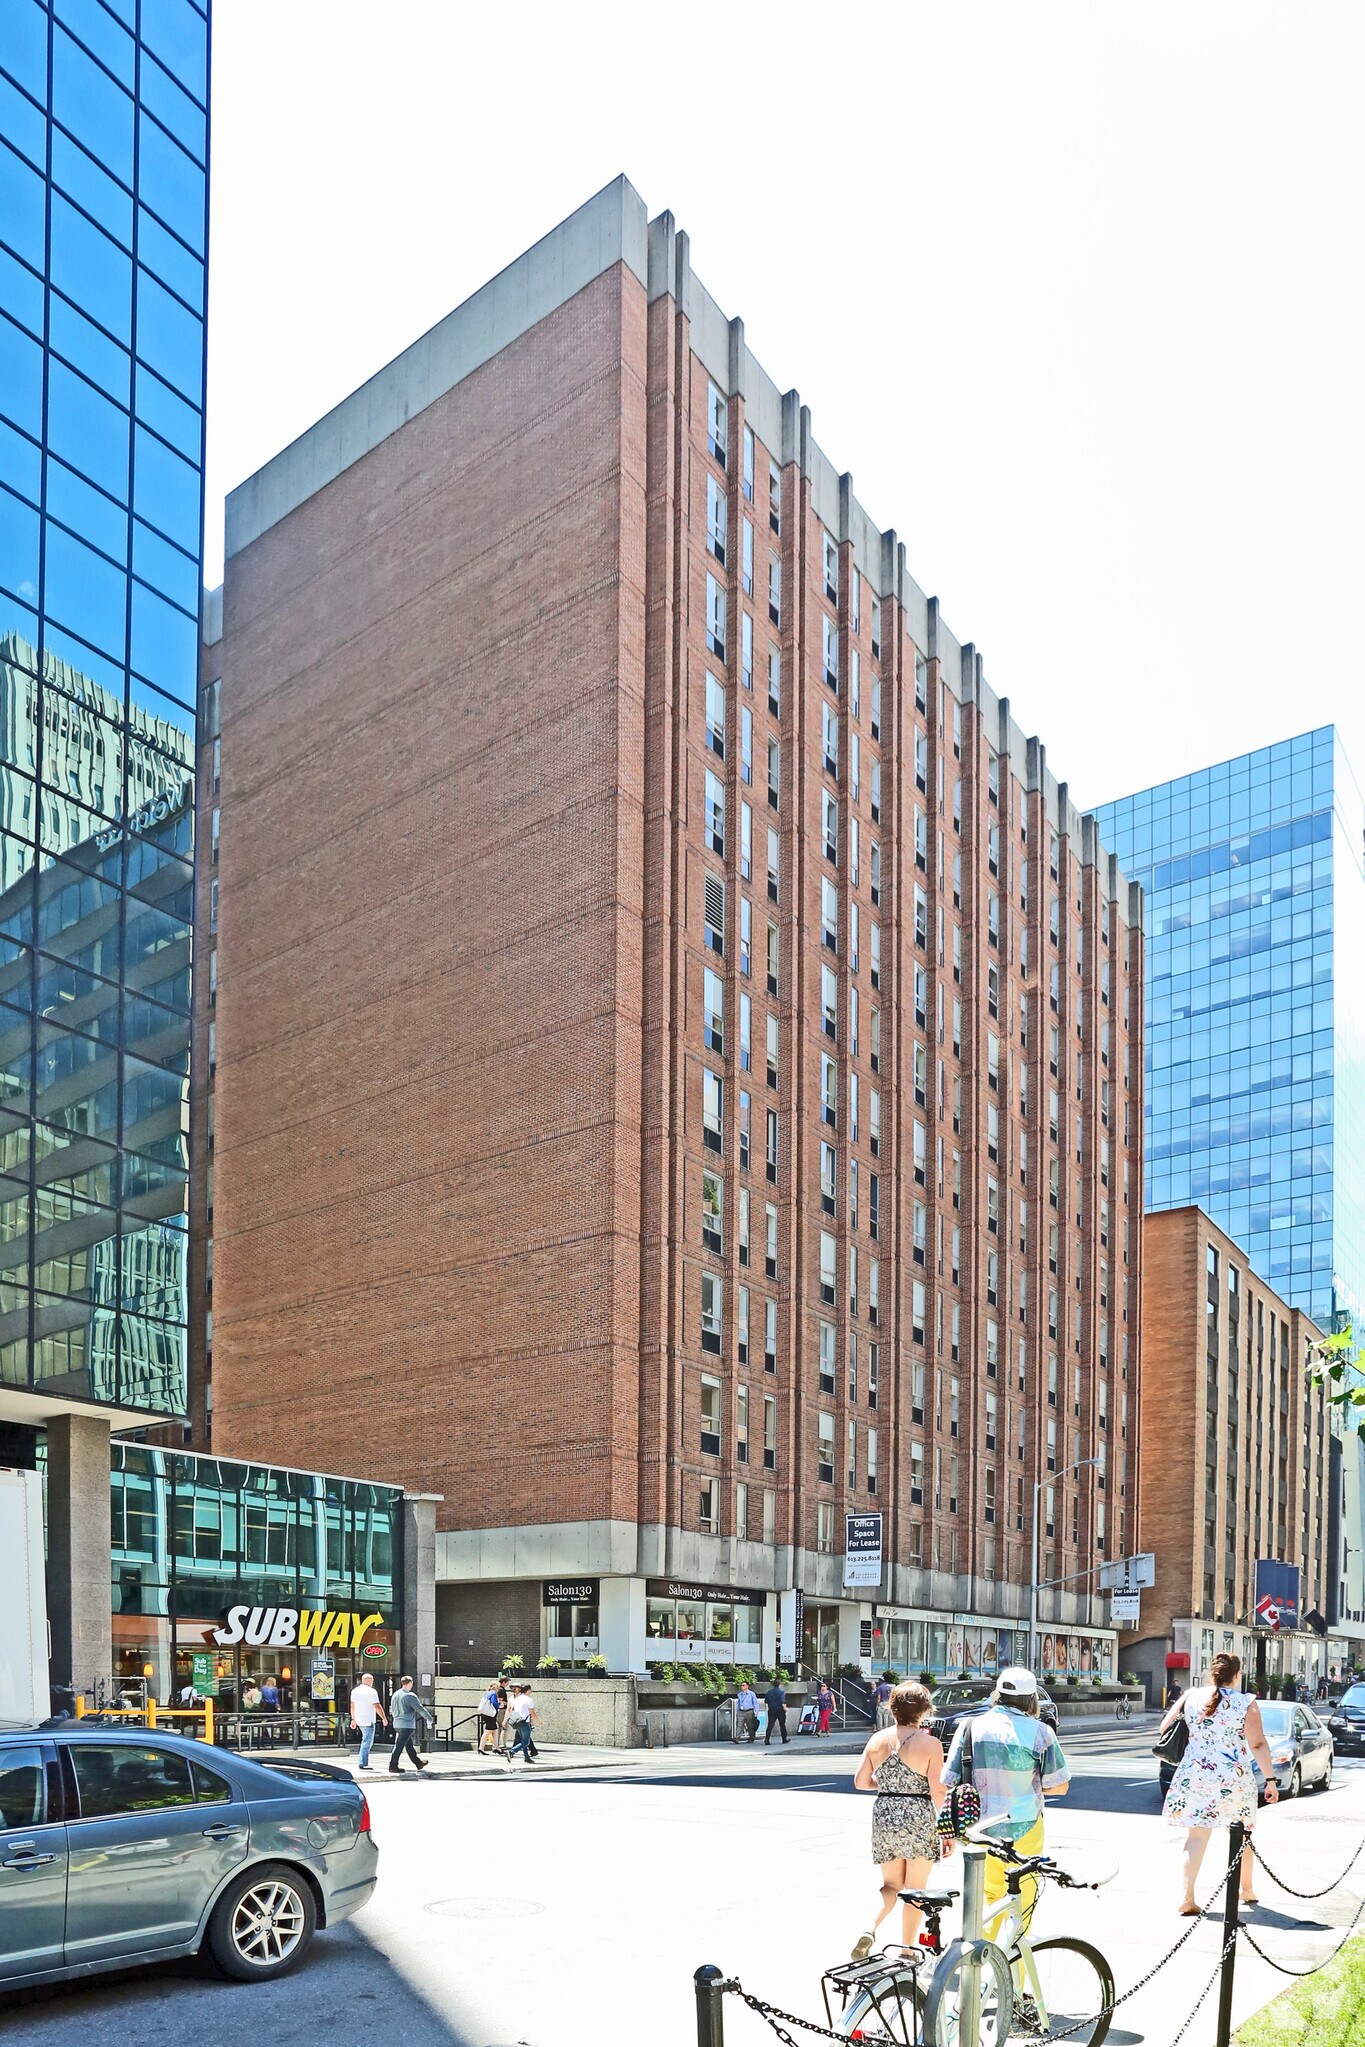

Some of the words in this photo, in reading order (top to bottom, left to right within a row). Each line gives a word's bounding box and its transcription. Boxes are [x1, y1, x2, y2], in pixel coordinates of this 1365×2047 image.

[854, 1520, 874, 1528] Office
[854, 1530, 875, 1538] Space
[548, 1584, 592, 1597] Salon130
[669, 1584, 703, 1599] Salon130
[212, 1605, 385, 1648] SUBWAY
[365, 1646, 384, 1655] OPEN
[194, 1667, 207, 1675] Day
